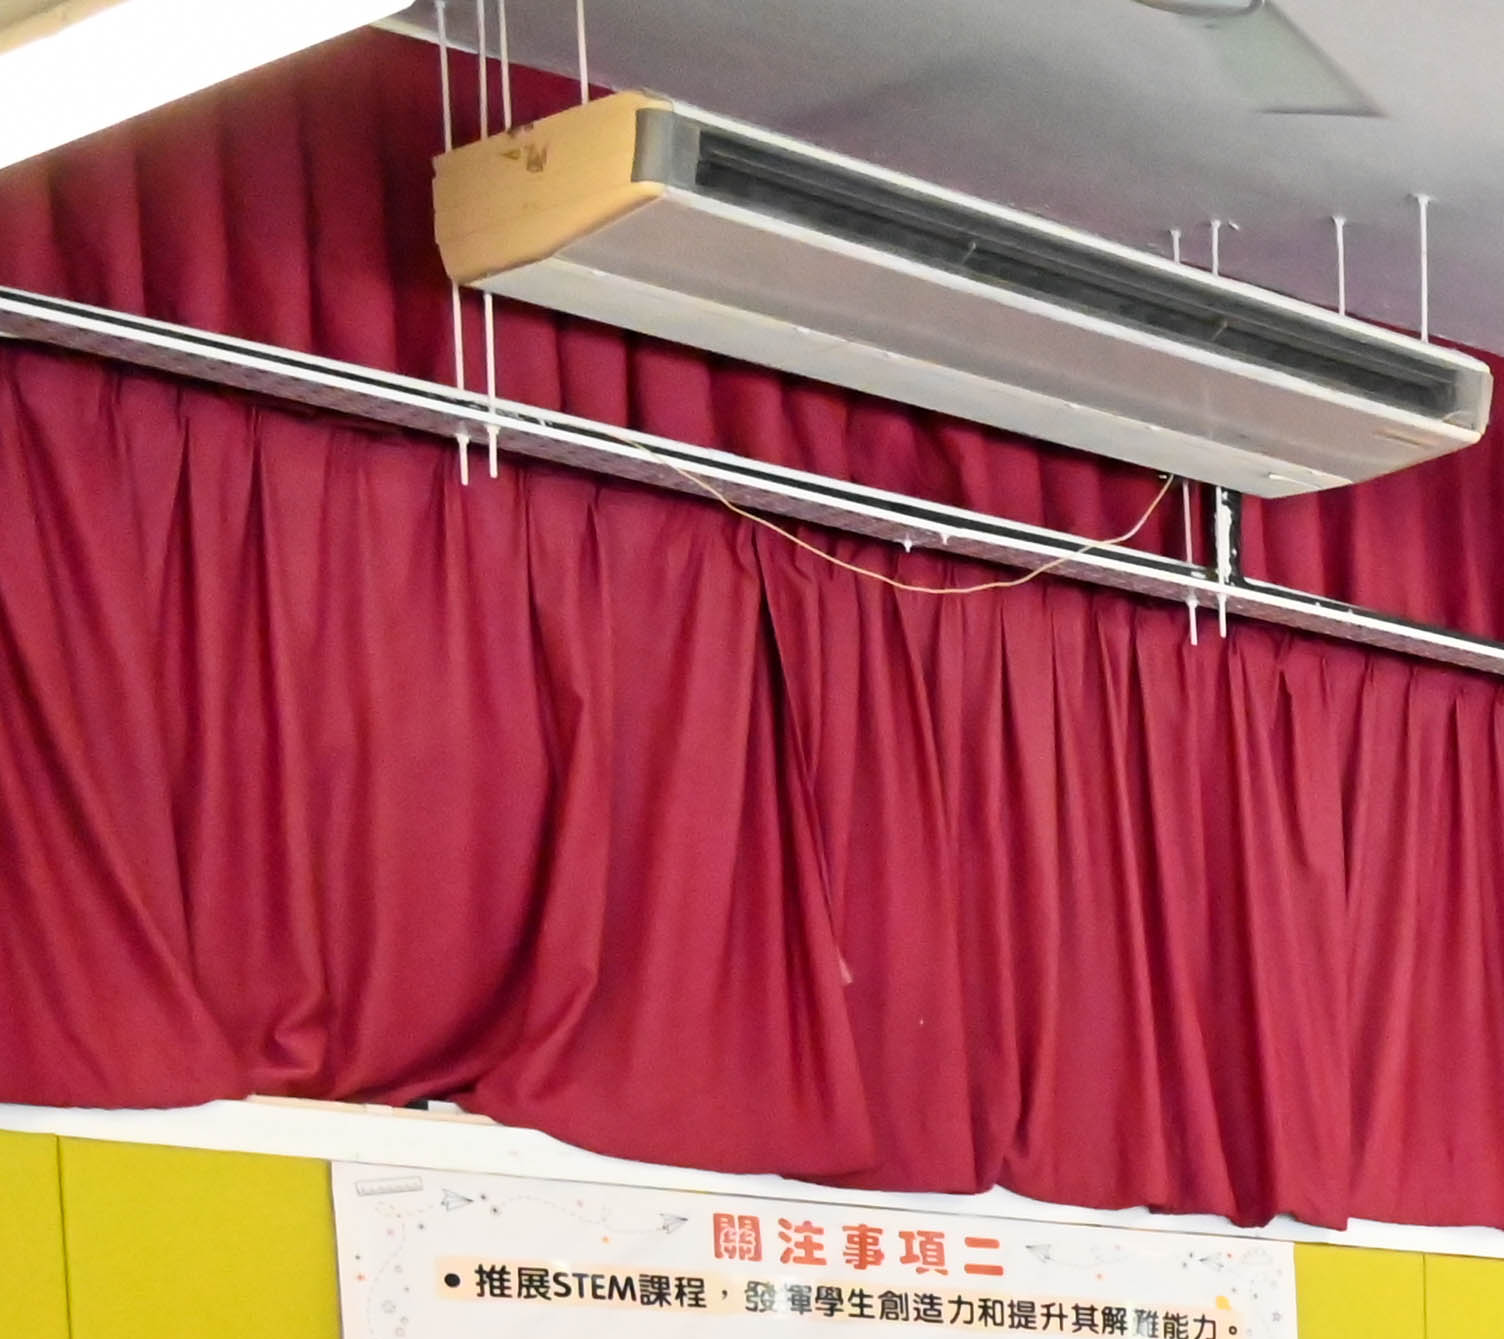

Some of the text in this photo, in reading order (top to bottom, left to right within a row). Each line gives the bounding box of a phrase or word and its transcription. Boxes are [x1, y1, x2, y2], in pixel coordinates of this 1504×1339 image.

[712, 1212, 1004, 1277] 關注事項二
